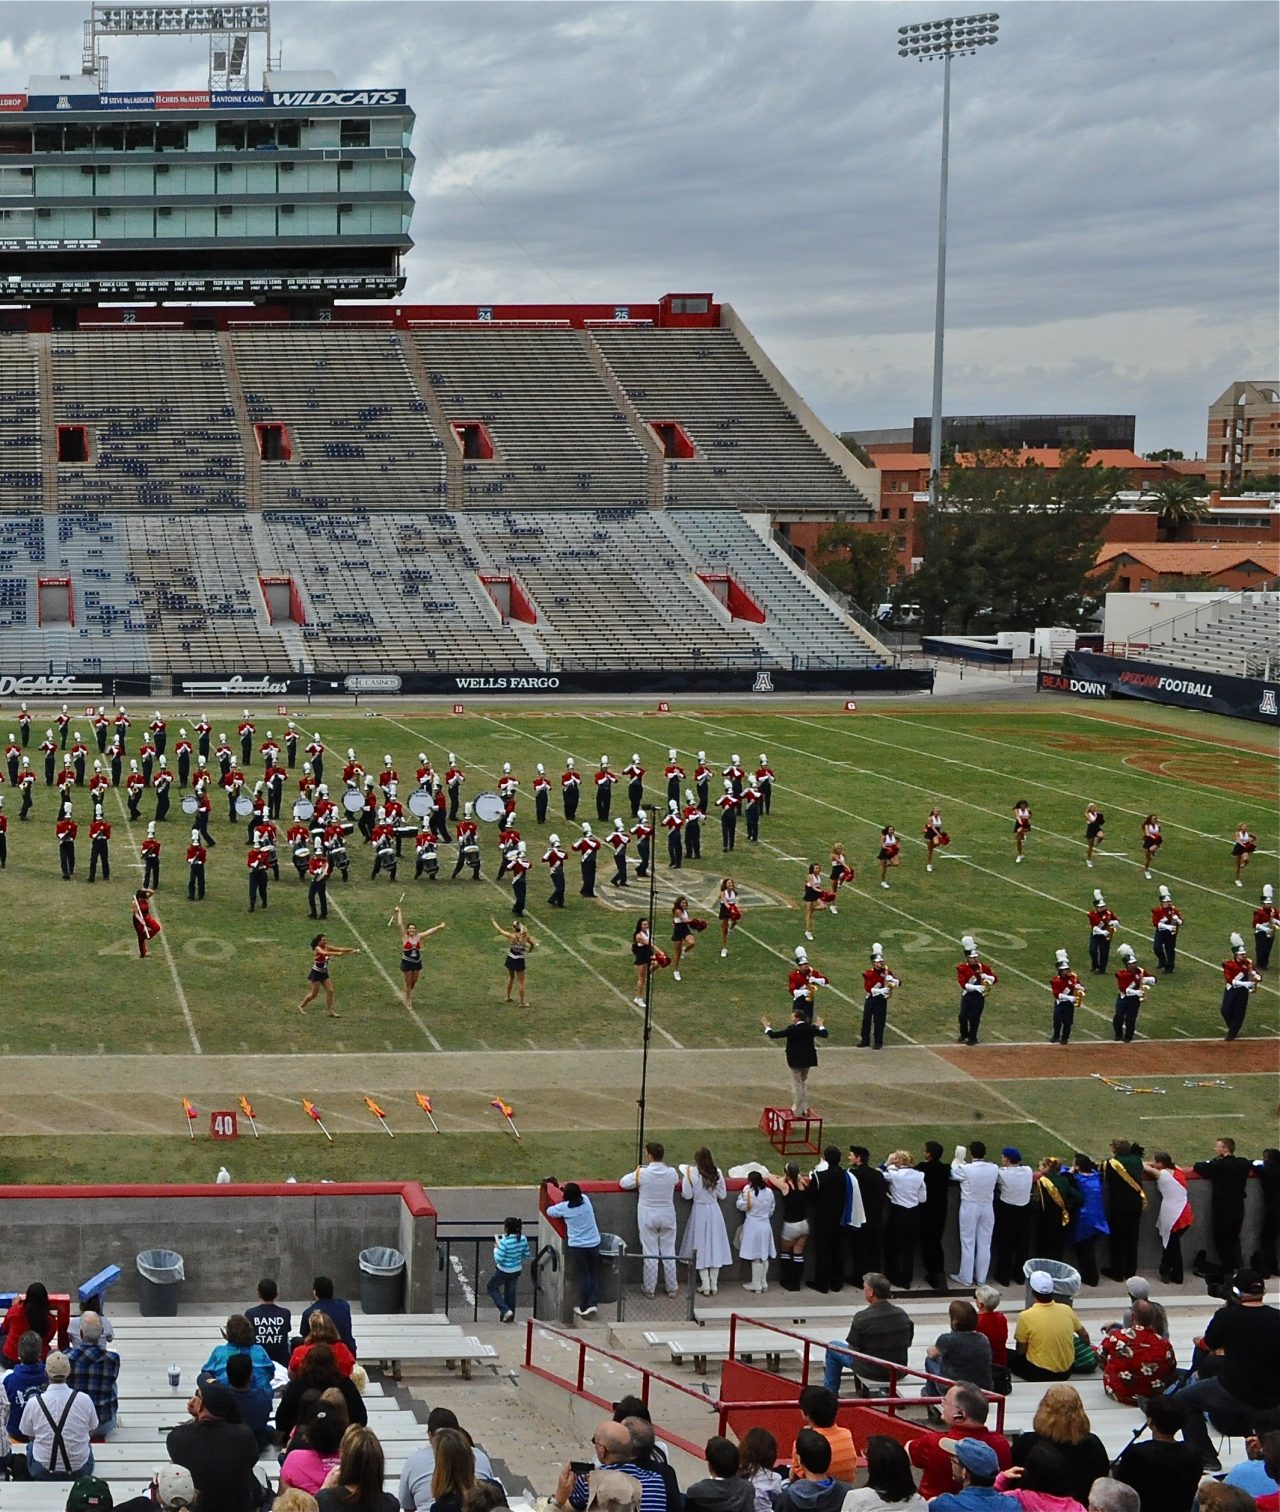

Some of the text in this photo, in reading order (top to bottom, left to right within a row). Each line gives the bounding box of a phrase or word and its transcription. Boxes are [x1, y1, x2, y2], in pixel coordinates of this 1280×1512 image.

[272, 92, 399, 106] WILDCATS
[123, 315, 136, 323] 22
[319, 312, 331, 321] 23
[478, 312, 491, 320] 24
[615, 311, 628, 320] 25
[455, 677, 560, 688] WELLS FARGO
[1042, 675, 1106, 696] BEAR DOWN
[1119, 671, 1213, 698] ARIZONA FOOTBALL
[214, 1115, 233, 1135] 40
[254, 1316, 284, 1326] BAND
[258, 1326, 281, 1335] DAY
[255, 1335, 283, 1344] STAFF
